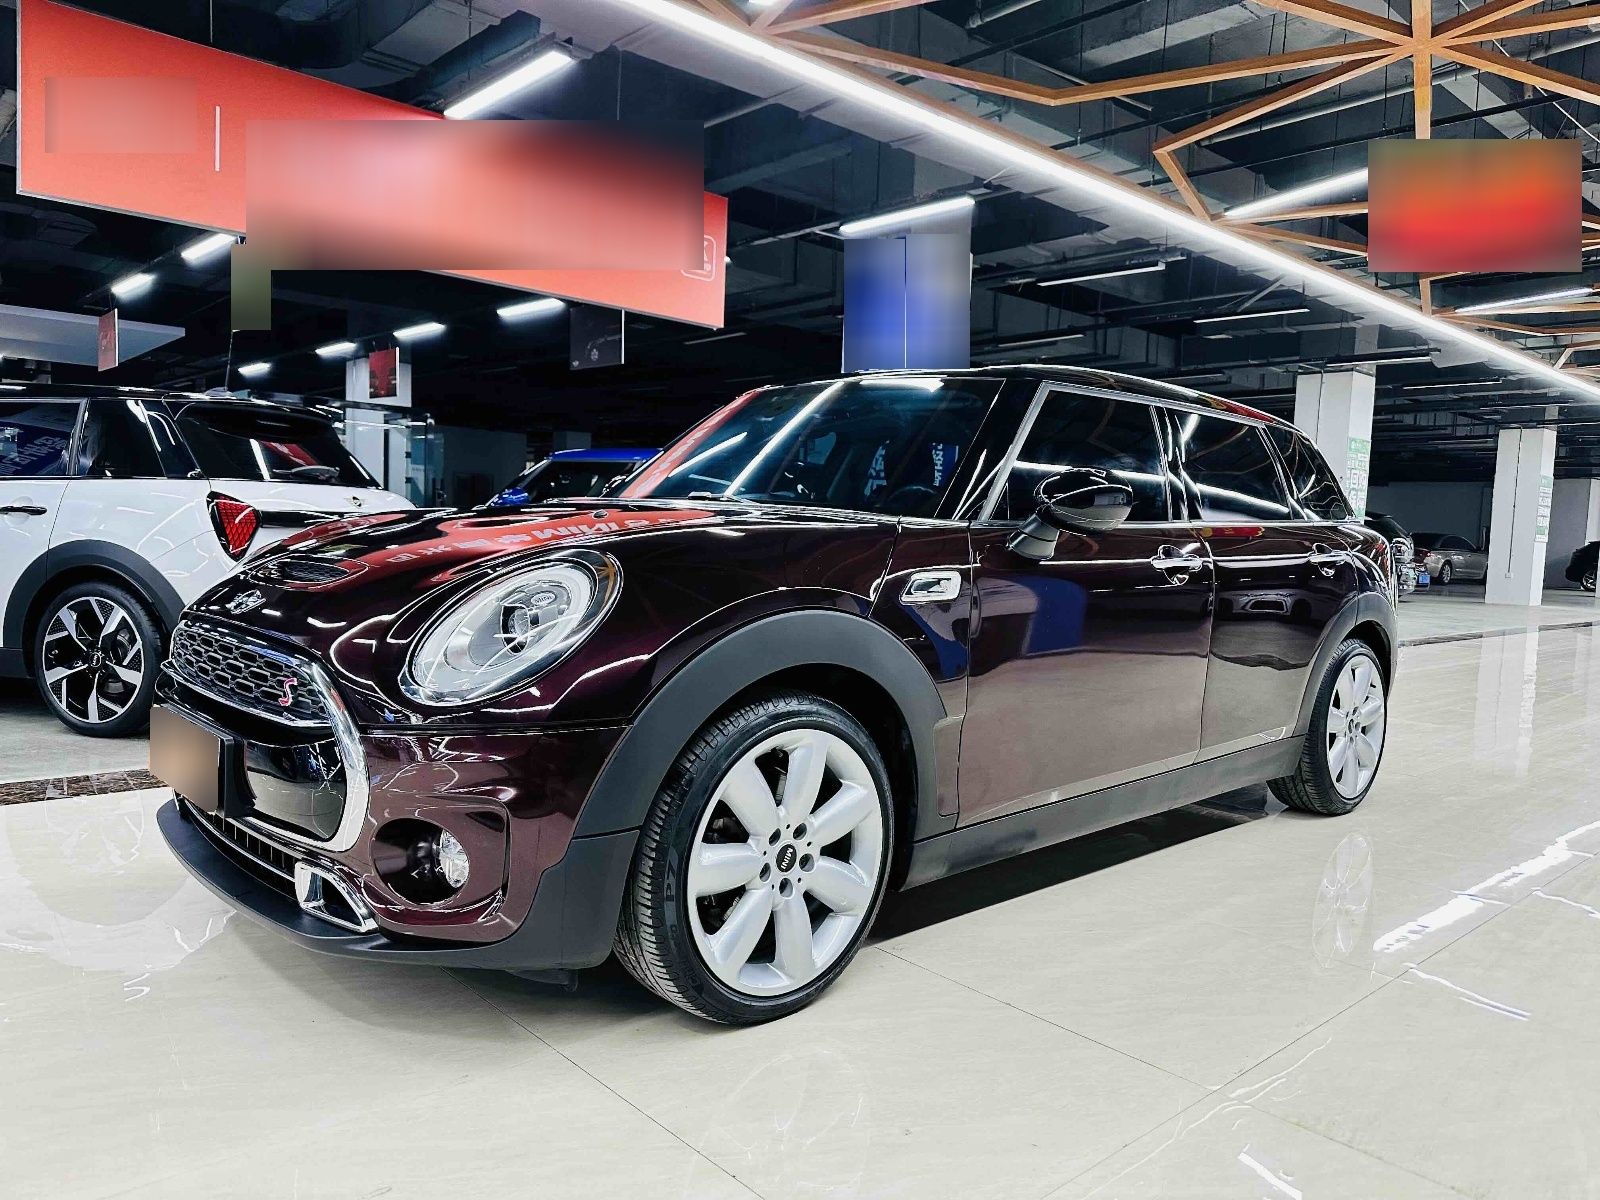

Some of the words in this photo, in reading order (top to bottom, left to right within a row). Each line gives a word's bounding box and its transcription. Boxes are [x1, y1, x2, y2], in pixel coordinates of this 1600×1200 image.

[278, 677, 298, 706] S
[781, 847, 793, 869] MINI
[665, 860, 677, 902] P7
